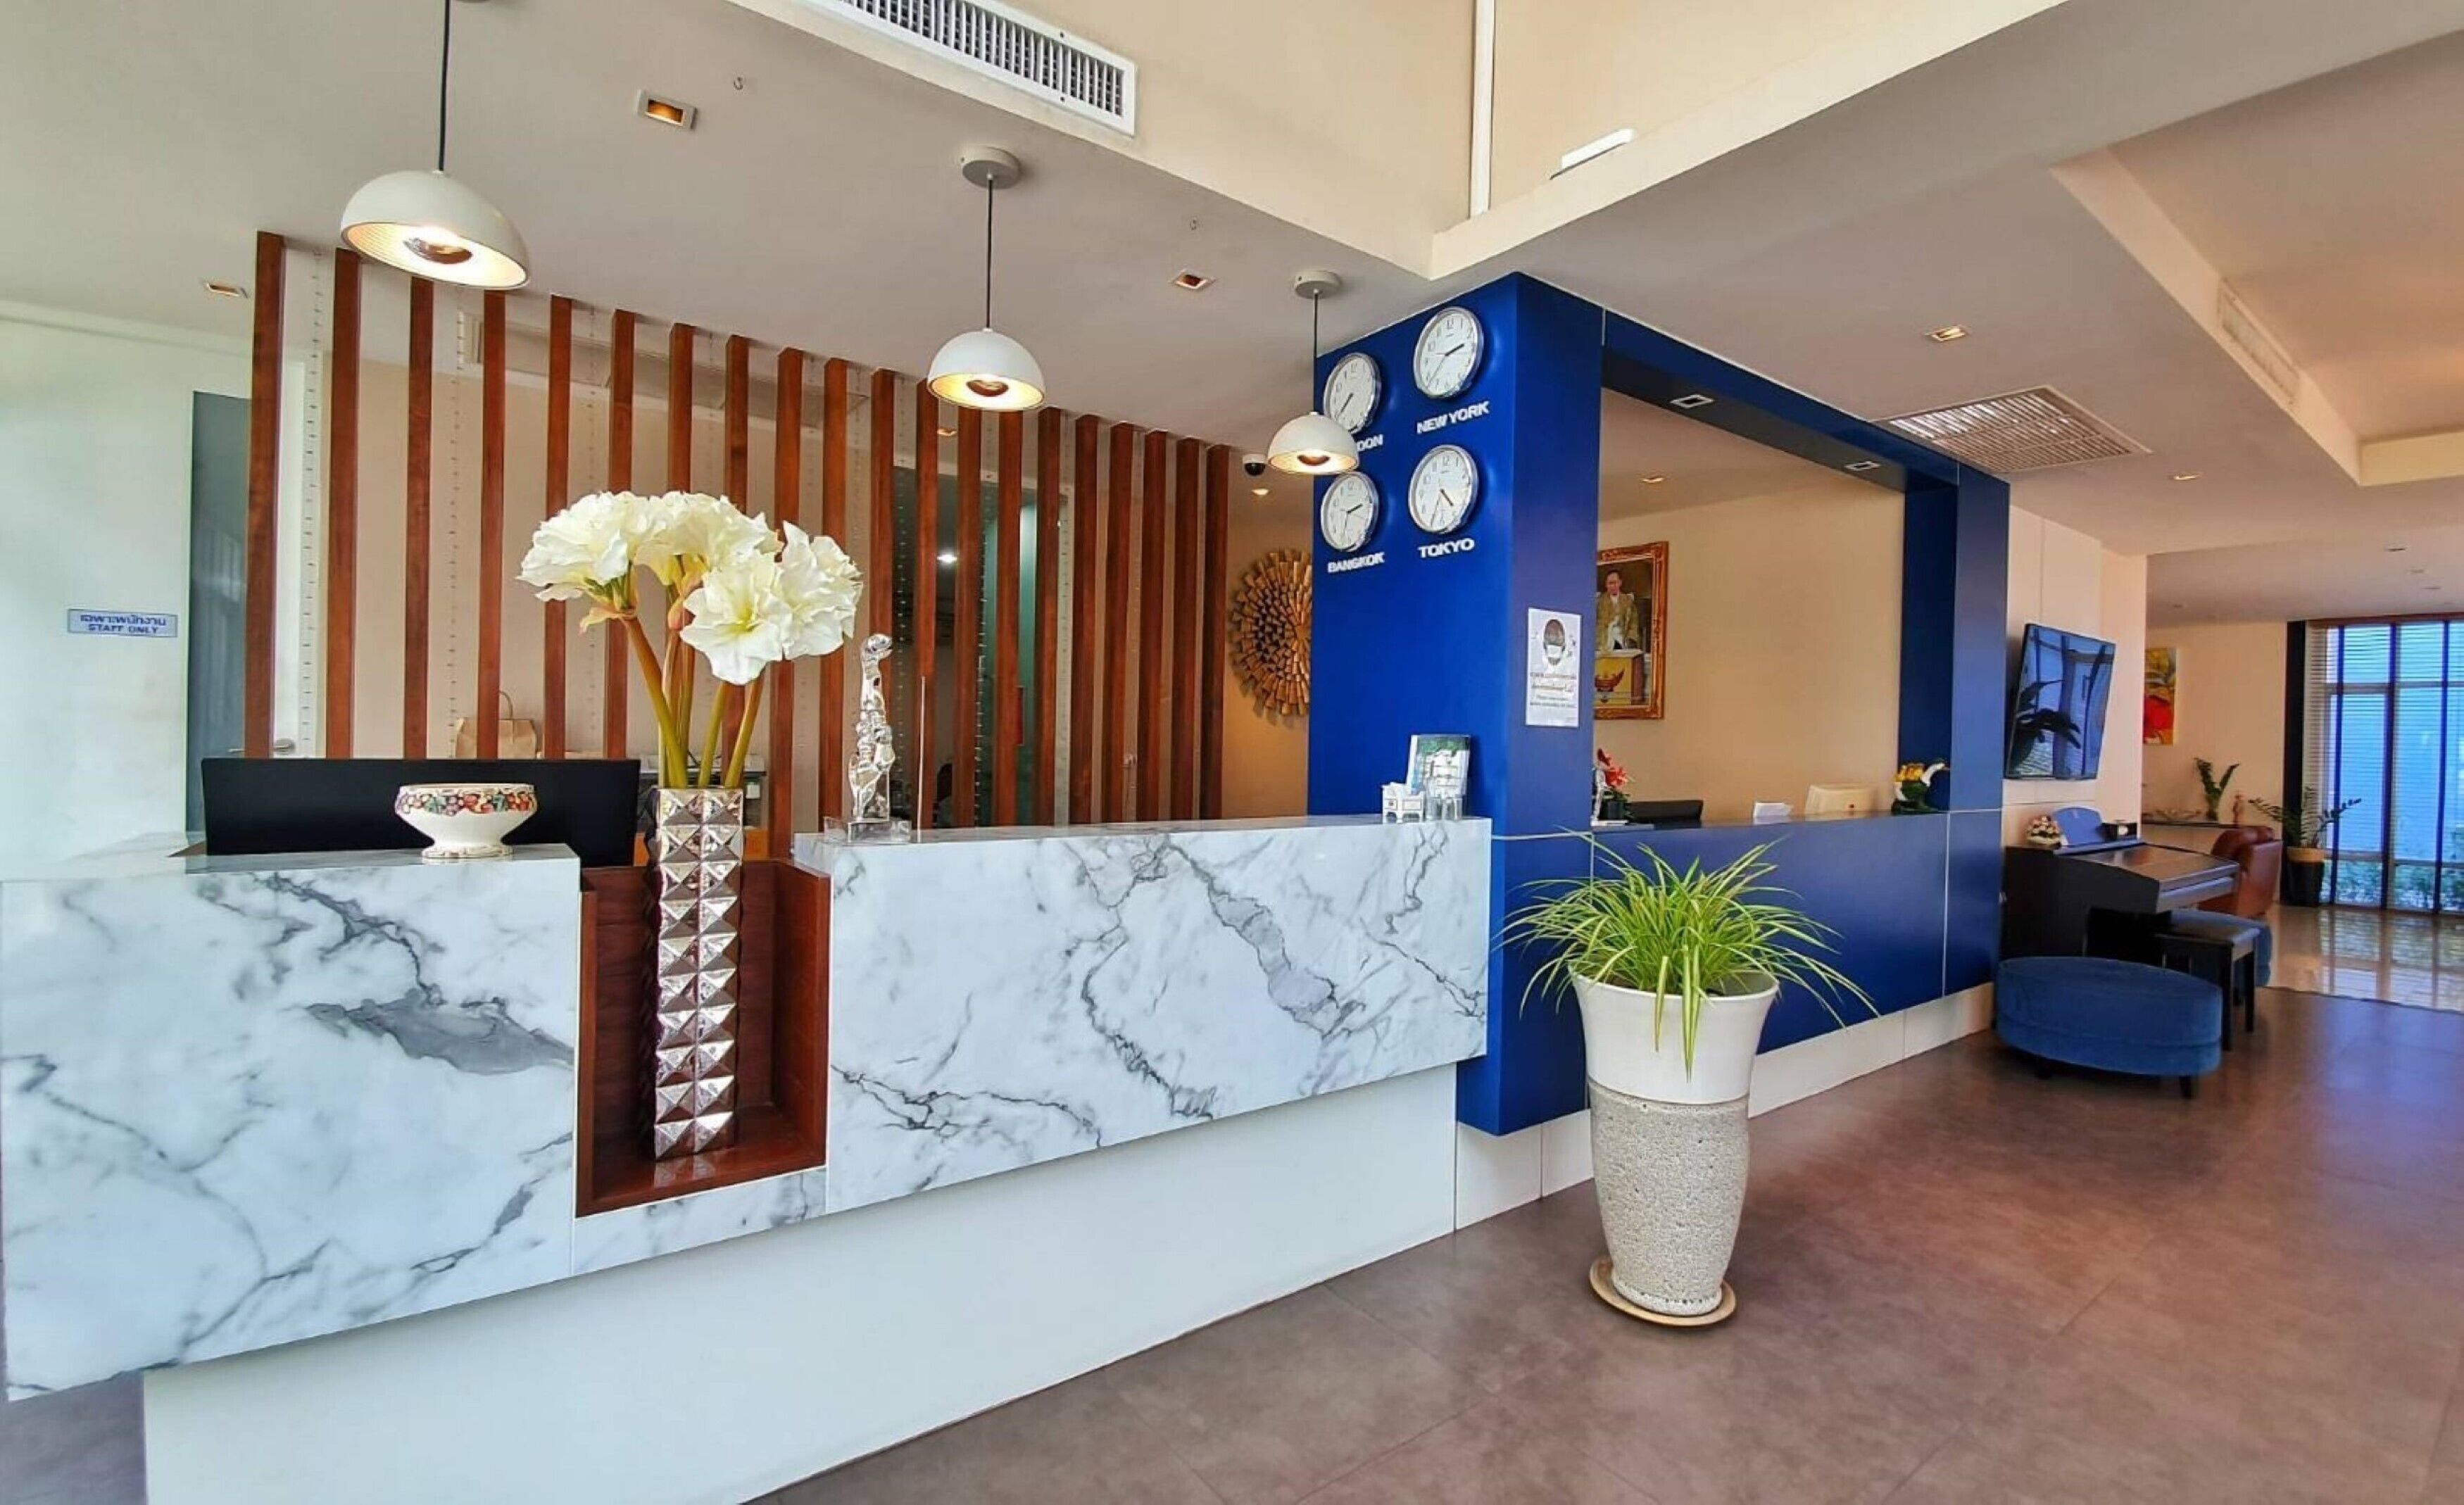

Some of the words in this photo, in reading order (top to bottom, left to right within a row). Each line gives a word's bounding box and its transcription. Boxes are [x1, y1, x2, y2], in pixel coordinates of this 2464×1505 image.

[1416, 415, 1447, 434] NEW
[1449, 401, 1490, 424] YORK
[1357, 434, 1384, 452] DON
[1418, 537, 1476, 559] TOKYO
[1327, 552, 1385, 573] BANGKOK
[80, 614, 167, 626] เฉพาะพนักงาน
[89, 624, 124, 632] STAFF
